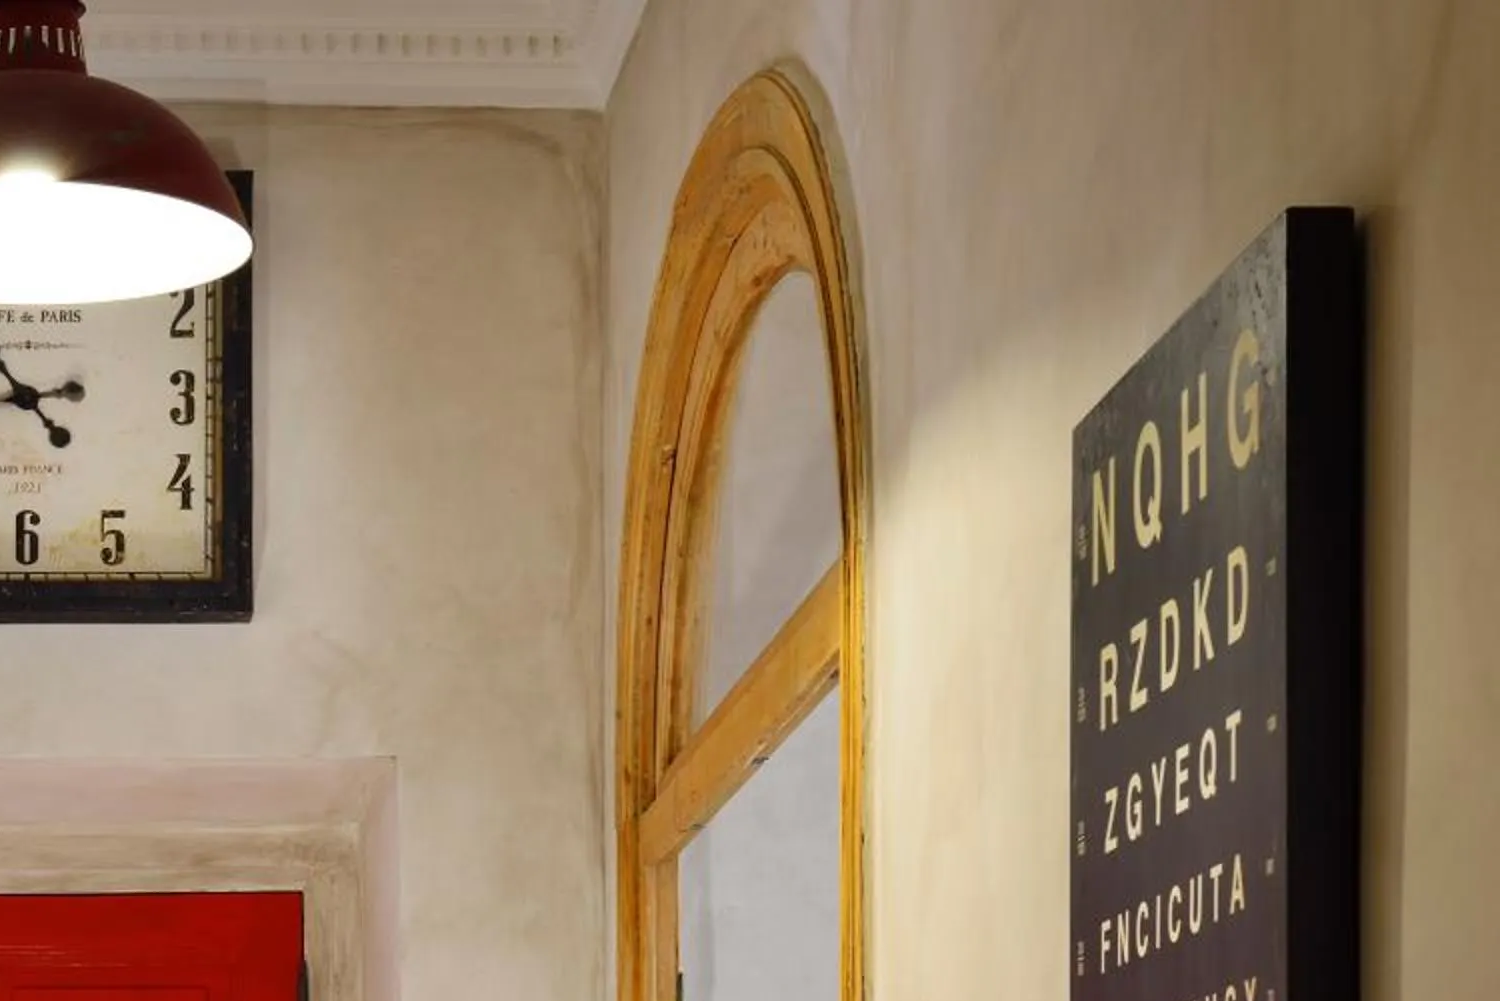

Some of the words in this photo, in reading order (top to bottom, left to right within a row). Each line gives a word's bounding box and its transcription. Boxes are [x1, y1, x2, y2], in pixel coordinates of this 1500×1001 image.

[20, 312, 34, 323] de
[40, 310, 82, 323] PARIS
[169, 287, 195, 338] 2
[169, 370, 196, 426] 3
[166, 454, 195, 511] 4
[1092, 328, 1261, 587] NQHG
[15, 509, 40, 566] 6
[100, 510, 126, 566] 5
[1100, 545, 1249, 732] RZDKD
[1104, 709, 1243, 854] ZGYEQT
[1100, 853, 1246, 975] FNCICUTA
